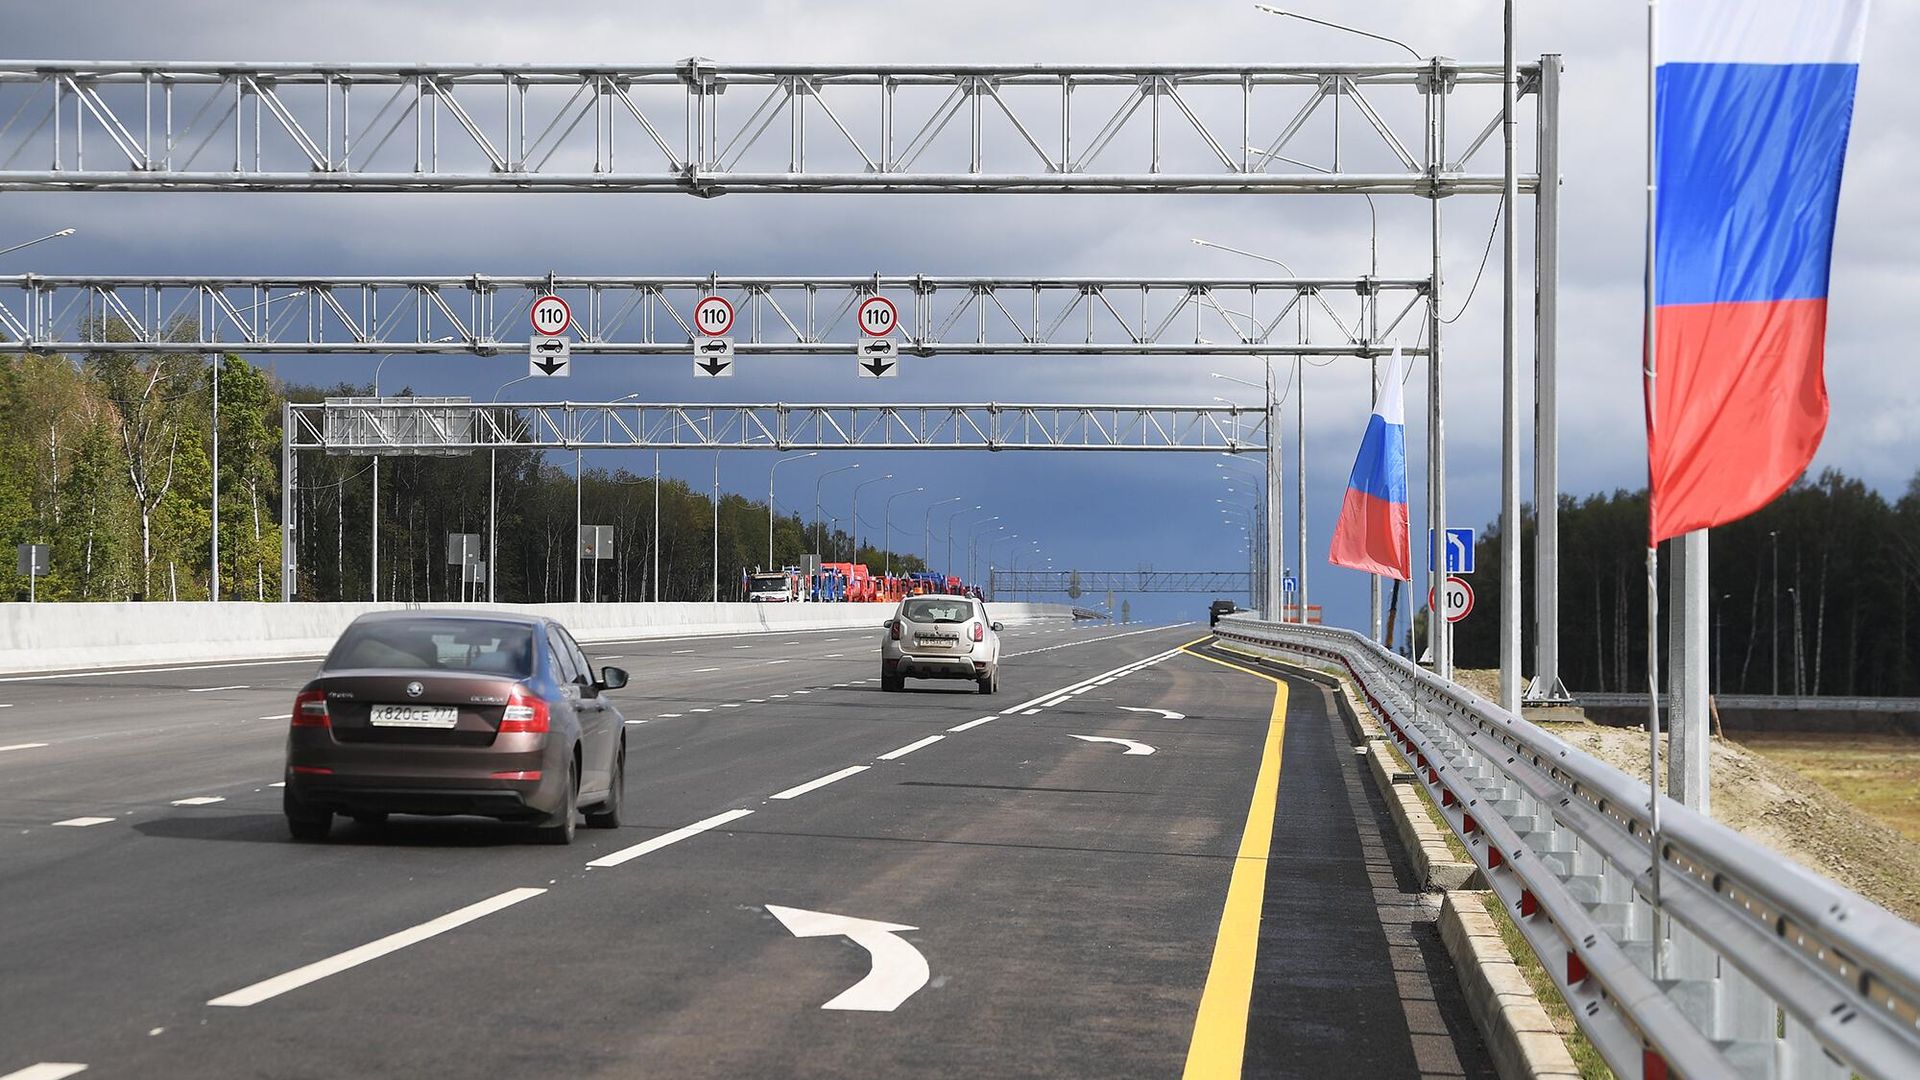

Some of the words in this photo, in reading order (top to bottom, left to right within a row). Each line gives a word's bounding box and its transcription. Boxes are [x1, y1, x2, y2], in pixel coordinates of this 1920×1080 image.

[539, 308, 563, 324] 110
[702, 308, 726, 324] 110
[866, 309, 890, 325] 110
[1446, 591, 1464, 609] 10
